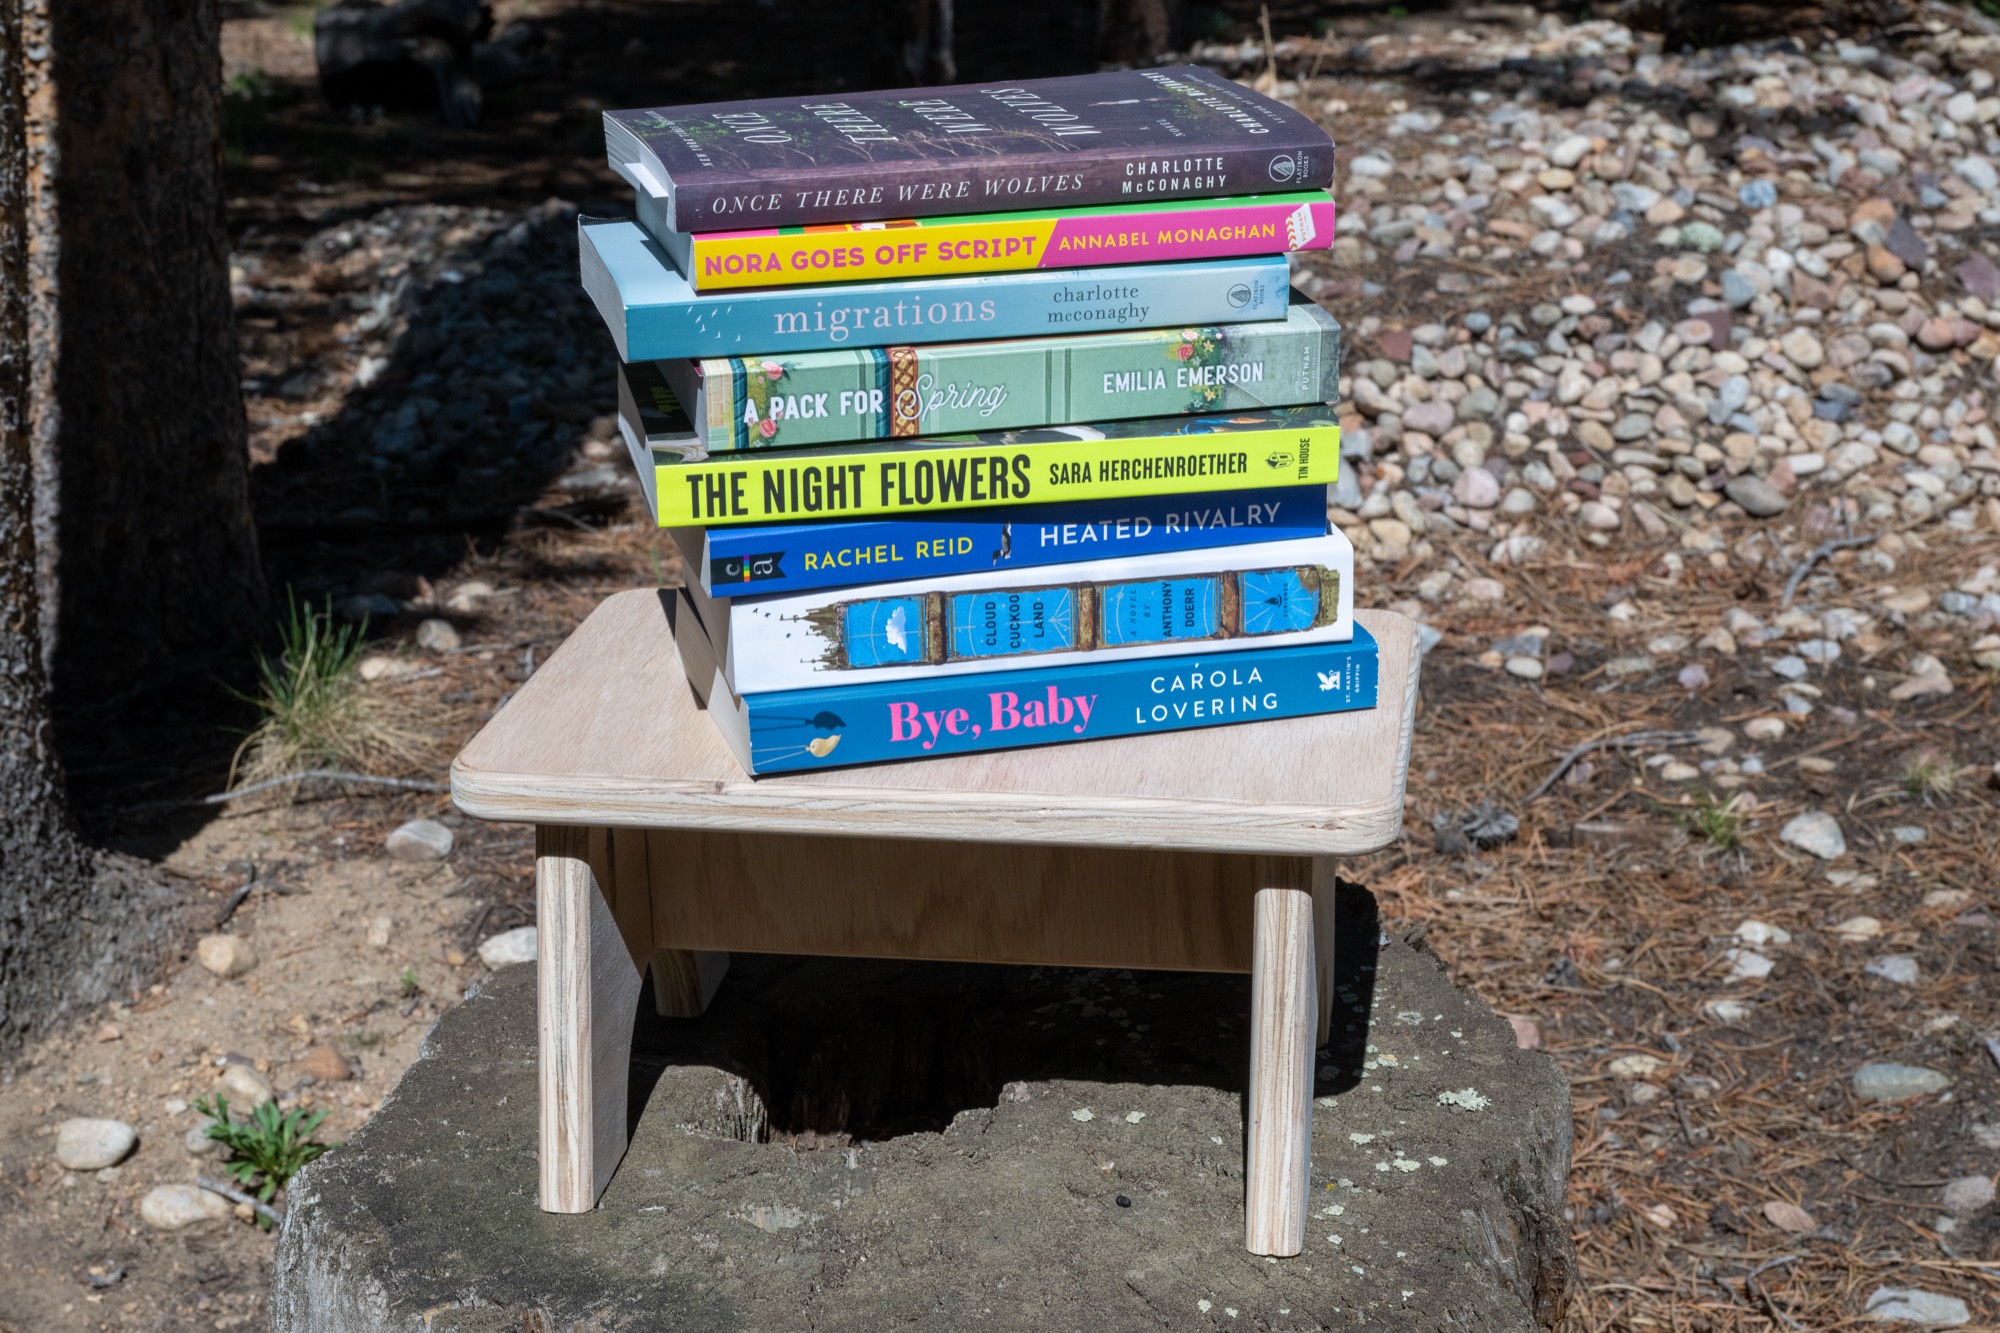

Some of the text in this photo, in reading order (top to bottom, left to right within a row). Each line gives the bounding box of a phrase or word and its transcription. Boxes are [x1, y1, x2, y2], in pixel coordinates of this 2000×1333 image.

[712, 113, 792, 143] ONCE
[801, 103, 900, 144] THERE
[898, 99, 993, 134] WERE
[979, 88, 1102, 136] WOLVES
[1156, 118, 1186, 137] NOVEL
[1197, 97, 1270, 134] CHARLOTTE
[1122, 175, 1226, 193] McCONAGHY
[1126, 157, 1224, 176] CHARLOTTE
[712, 173, 1084, 214] ONCE THERE WERE WOLVES
[1059, 223, 1276, 251] ANNABEL MONAGHAN
[705, 236, 1037, 276] NORA GOES OFF SCRIPT
[1053, 285, 1139, 303] charlotte
[774, 295, 996, 342] migrations
[1047, 302, 1150, 324] mcconaghy
[1103, 362, 1264, 394] EMILIA EMERSON
[1301, 346, 1311, 391] PUTNAM
[743, 373, 1008, 424] A PACK FOR Spring
[1049, 452, 1248, 485] SARA HERCHENROETHER
[1298, 437, 1310, 480] TIN HOUSE
[685, 454, 1031, 519] THE NIGHT FLOWERS
[1040, 502, 1281, 547] HEATED RIVALRY
[804, 537, 973, 571] RACHEL REID
[985, 601, 997, 646] CLOUD
[1009, 594, 1020, 649] CUCKOO
[1033, 602, 1044, 638] LAND
[1144, 605, 1151, 618] BY
[1162, 582, 1172, 637] ANTHONY
[1185, 588, 1195, 627] DOERR
[1151, 666, 1263, 694] CAROLA
[887, 686, 1098, 750] Bye, Baby
[1136, 692, 1278, 724] LOVERING
